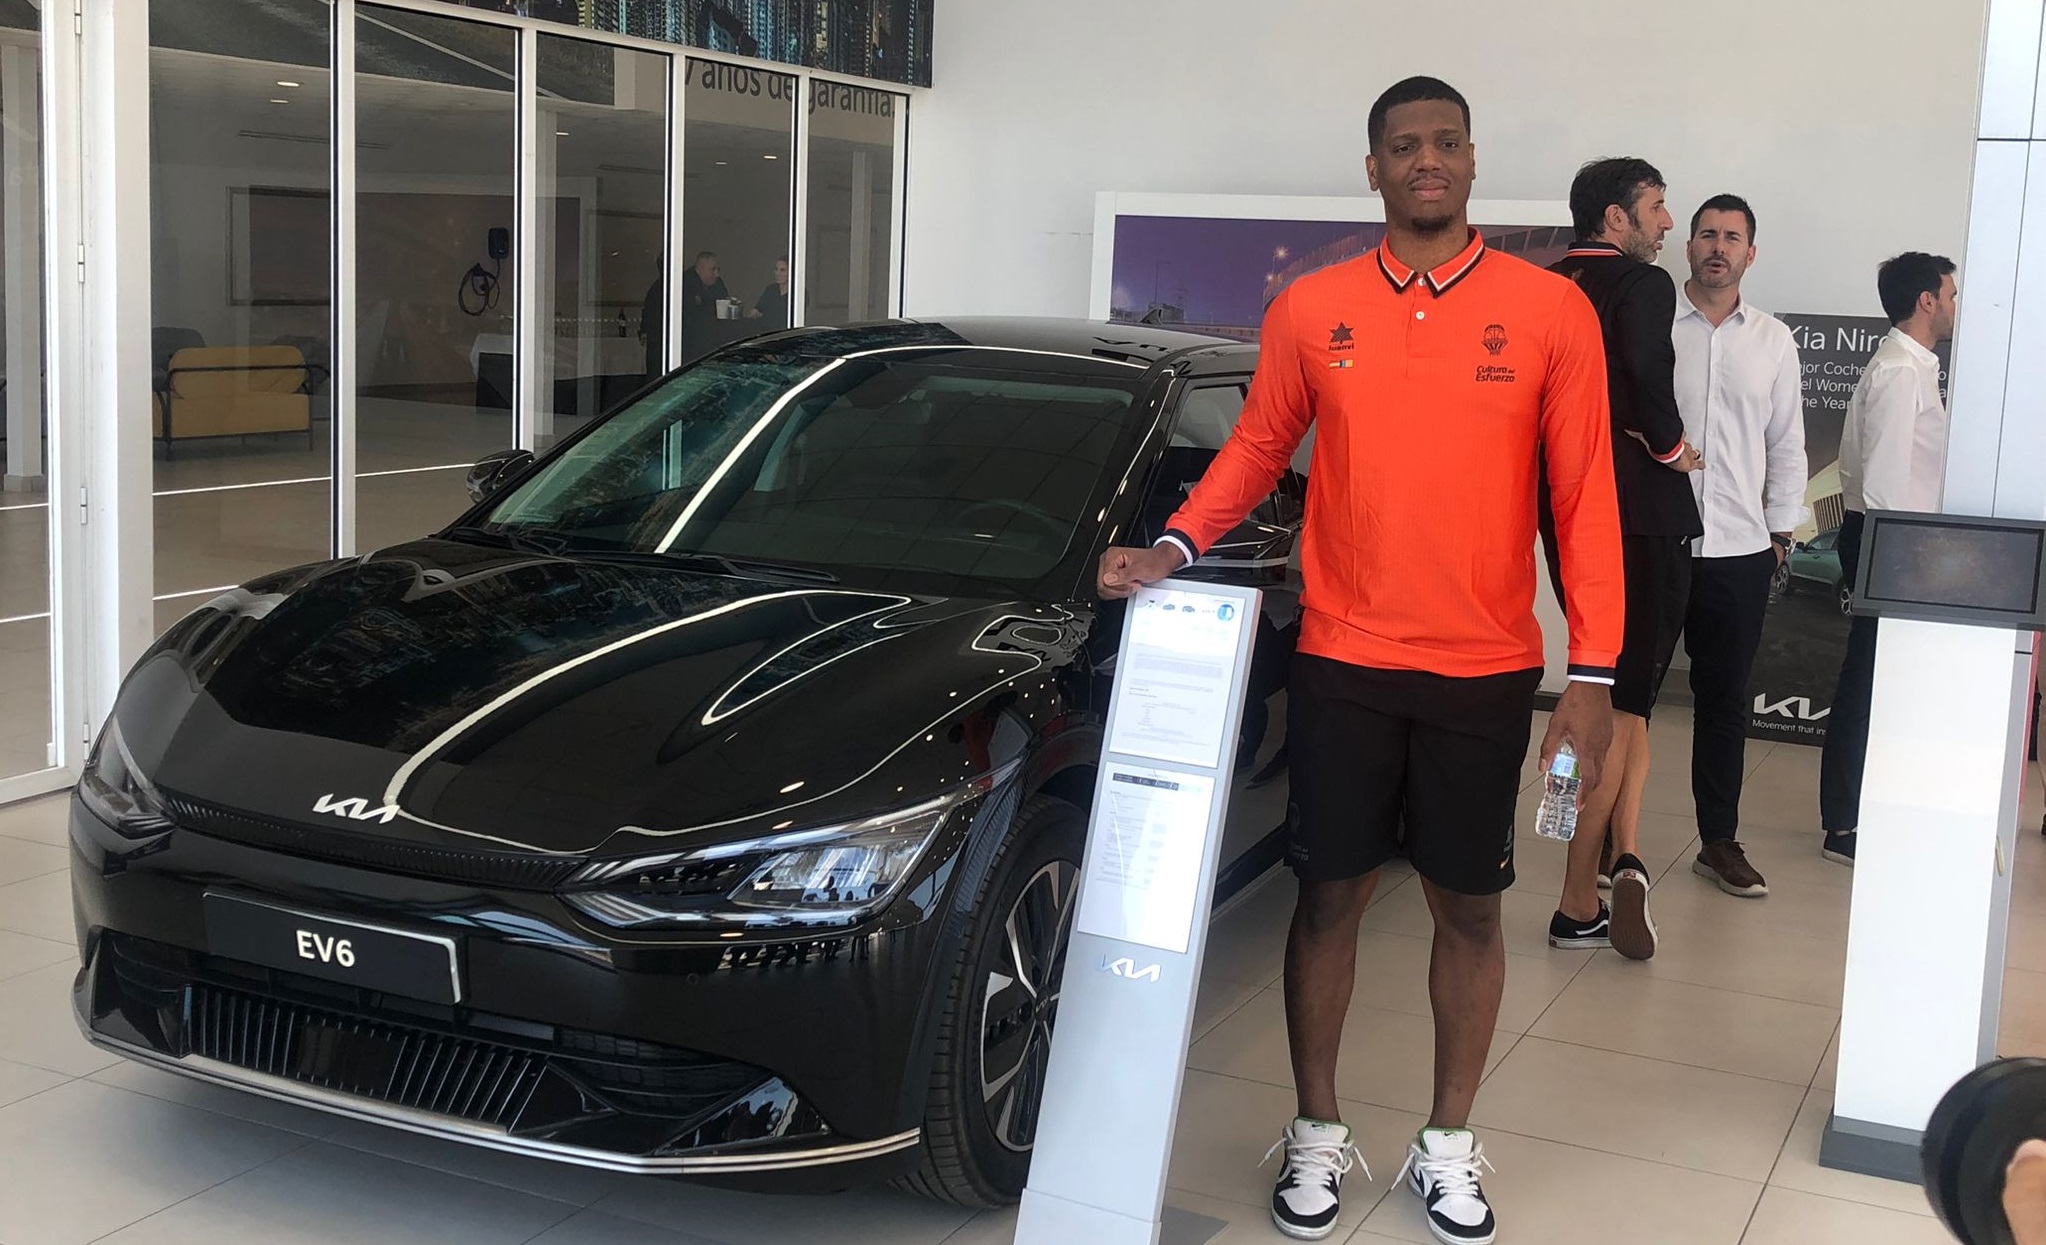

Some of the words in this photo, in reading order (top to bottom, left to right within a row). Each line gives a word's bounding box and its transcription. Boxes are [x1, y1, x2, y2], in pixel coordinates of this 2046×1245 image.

[1476, 365, 1507, 374] Cultura
[1800, 361, 1820, 376] jor
[1824, 362, 1866, 376] Coche
[1475, 373, 1515, 382] Esfuerzo
[1801, 378, 1812, 390] el
[1816, 378, 1858, 393] Wome
[1801, 395, 1817, 408] he
[1752, 719, 1795, 732] Movement
[1798, 725, 1814, 735] that
[312, 793, 400, 824] KIA
[296, 930, 355, 967] EV6
[1098, 954, 1161, 982] KIA
